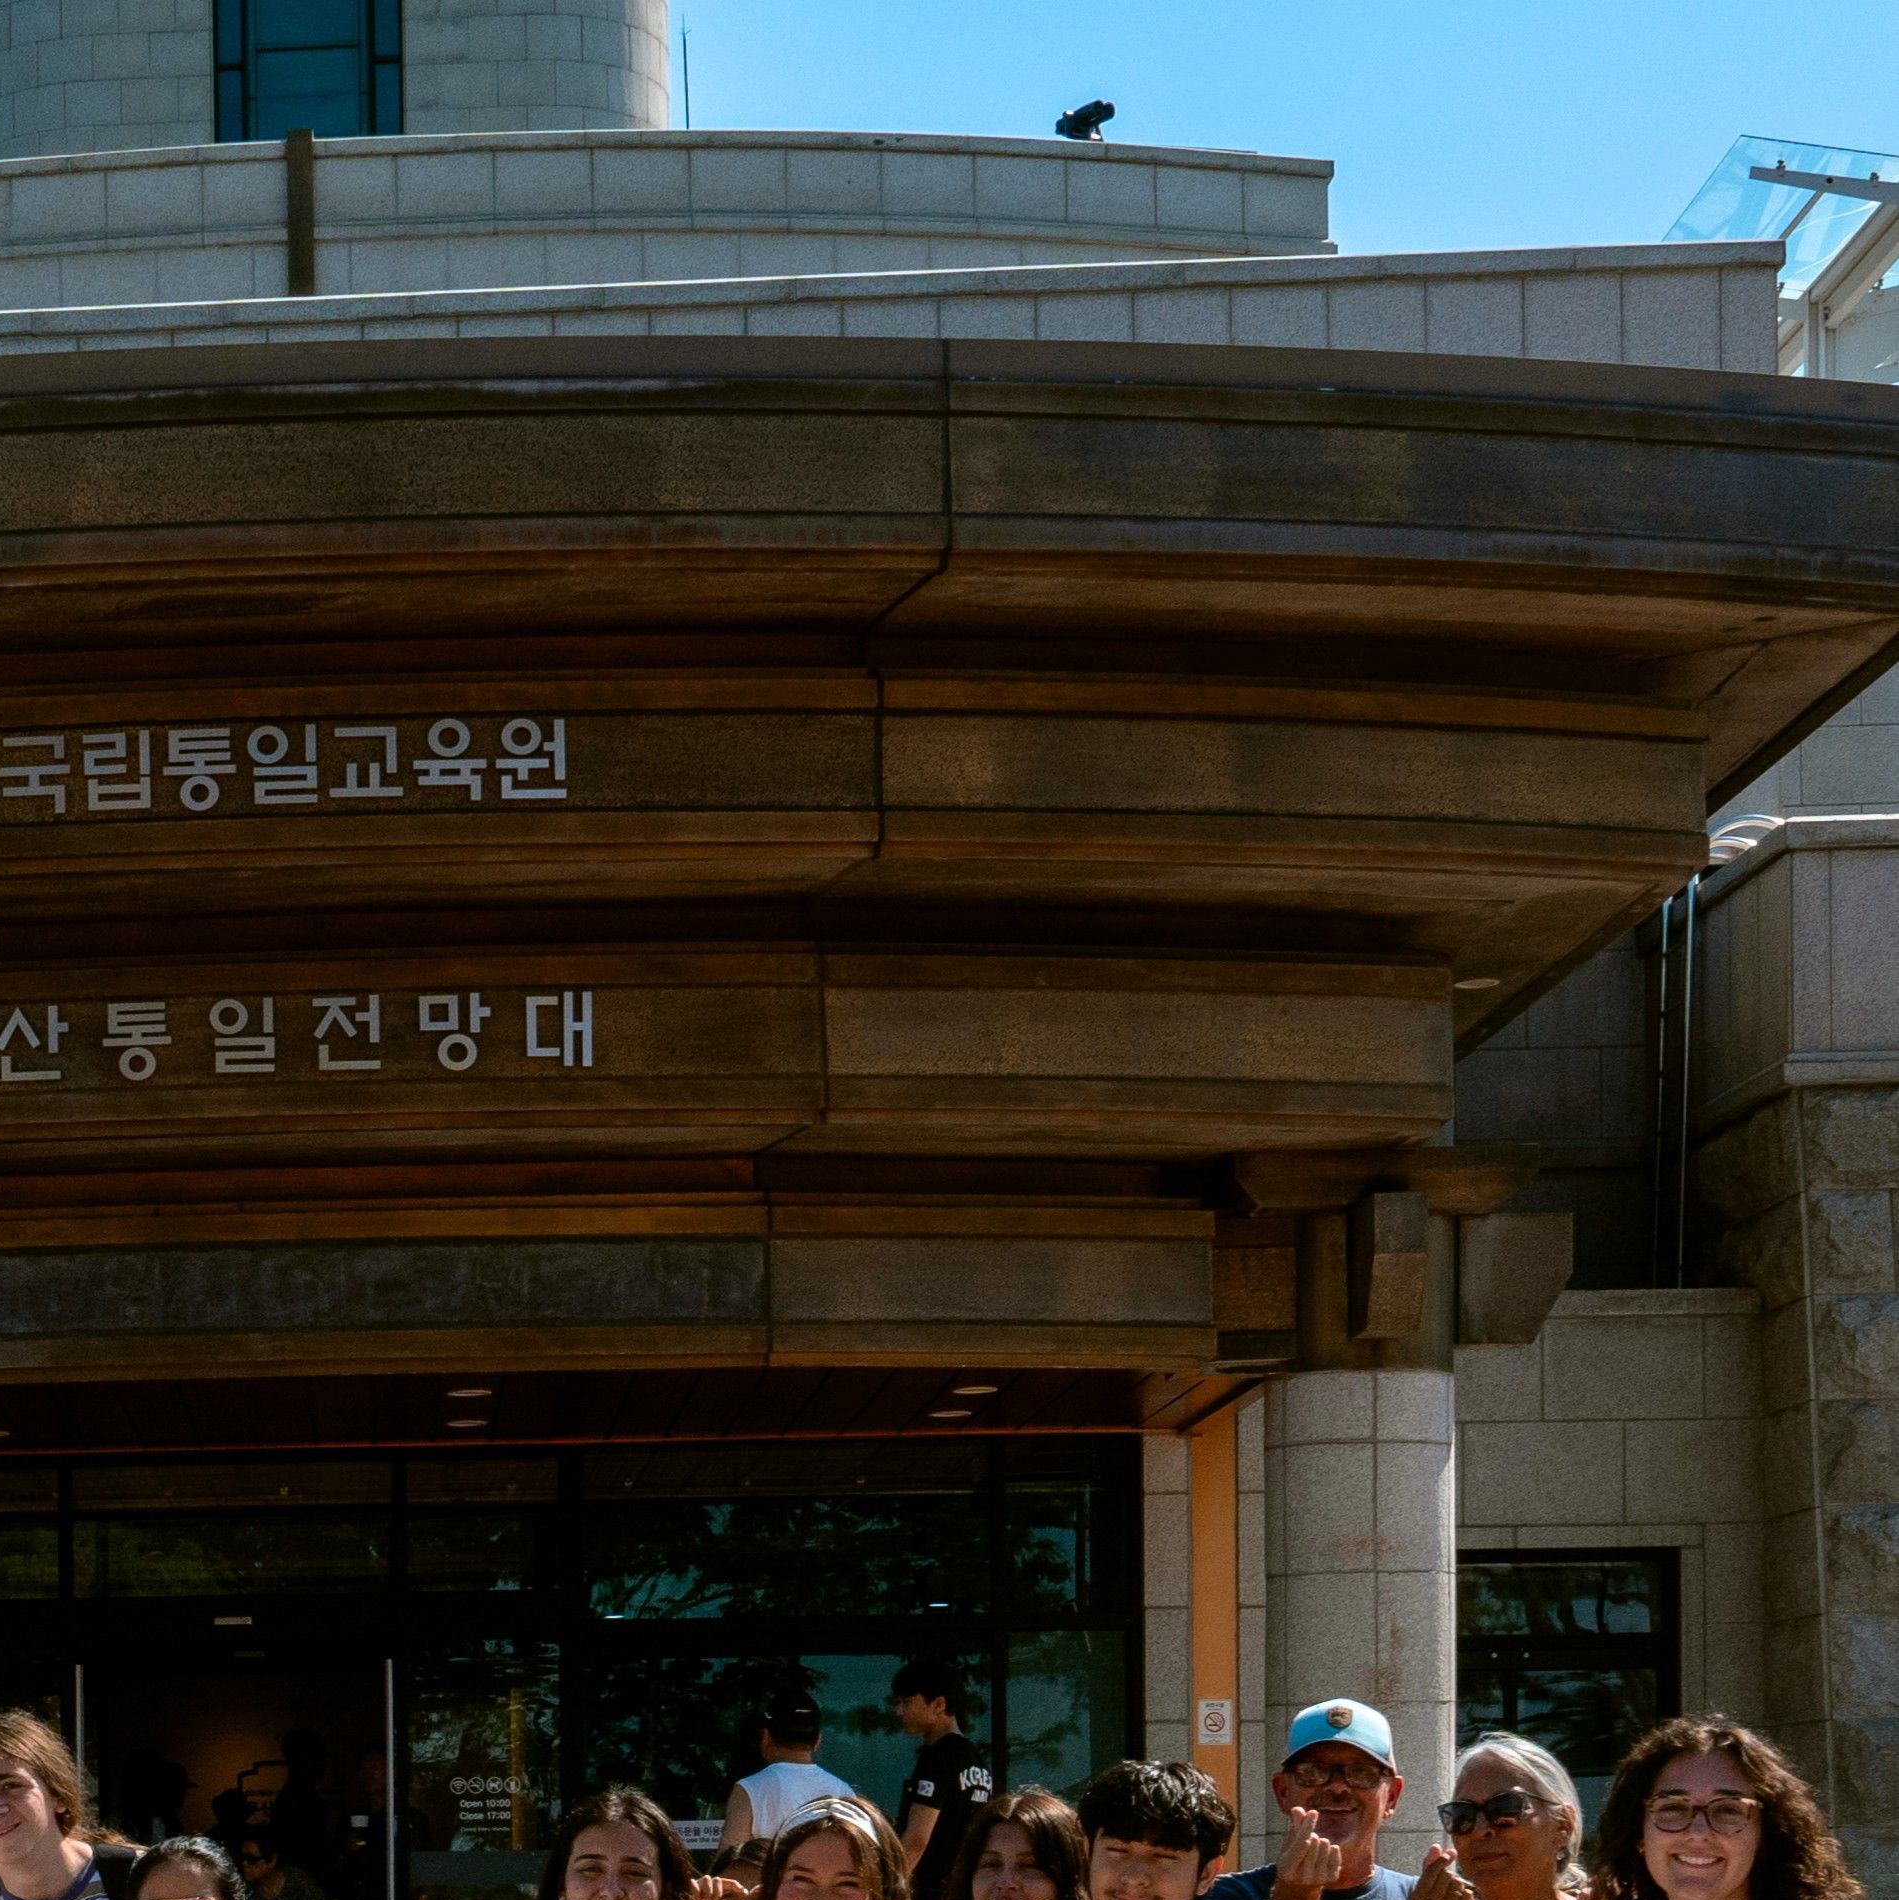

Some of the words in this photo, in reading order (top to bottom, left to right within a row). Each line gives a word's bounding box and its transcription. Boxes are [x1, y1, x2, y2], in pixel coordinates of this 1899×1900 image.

[459, 1799, 483, 1808] Open
[486, 1799, 511, 1808] 10:00
[459, 1811, 484, 1820] Close
[487, 1811, 511, 1820] 17:00
